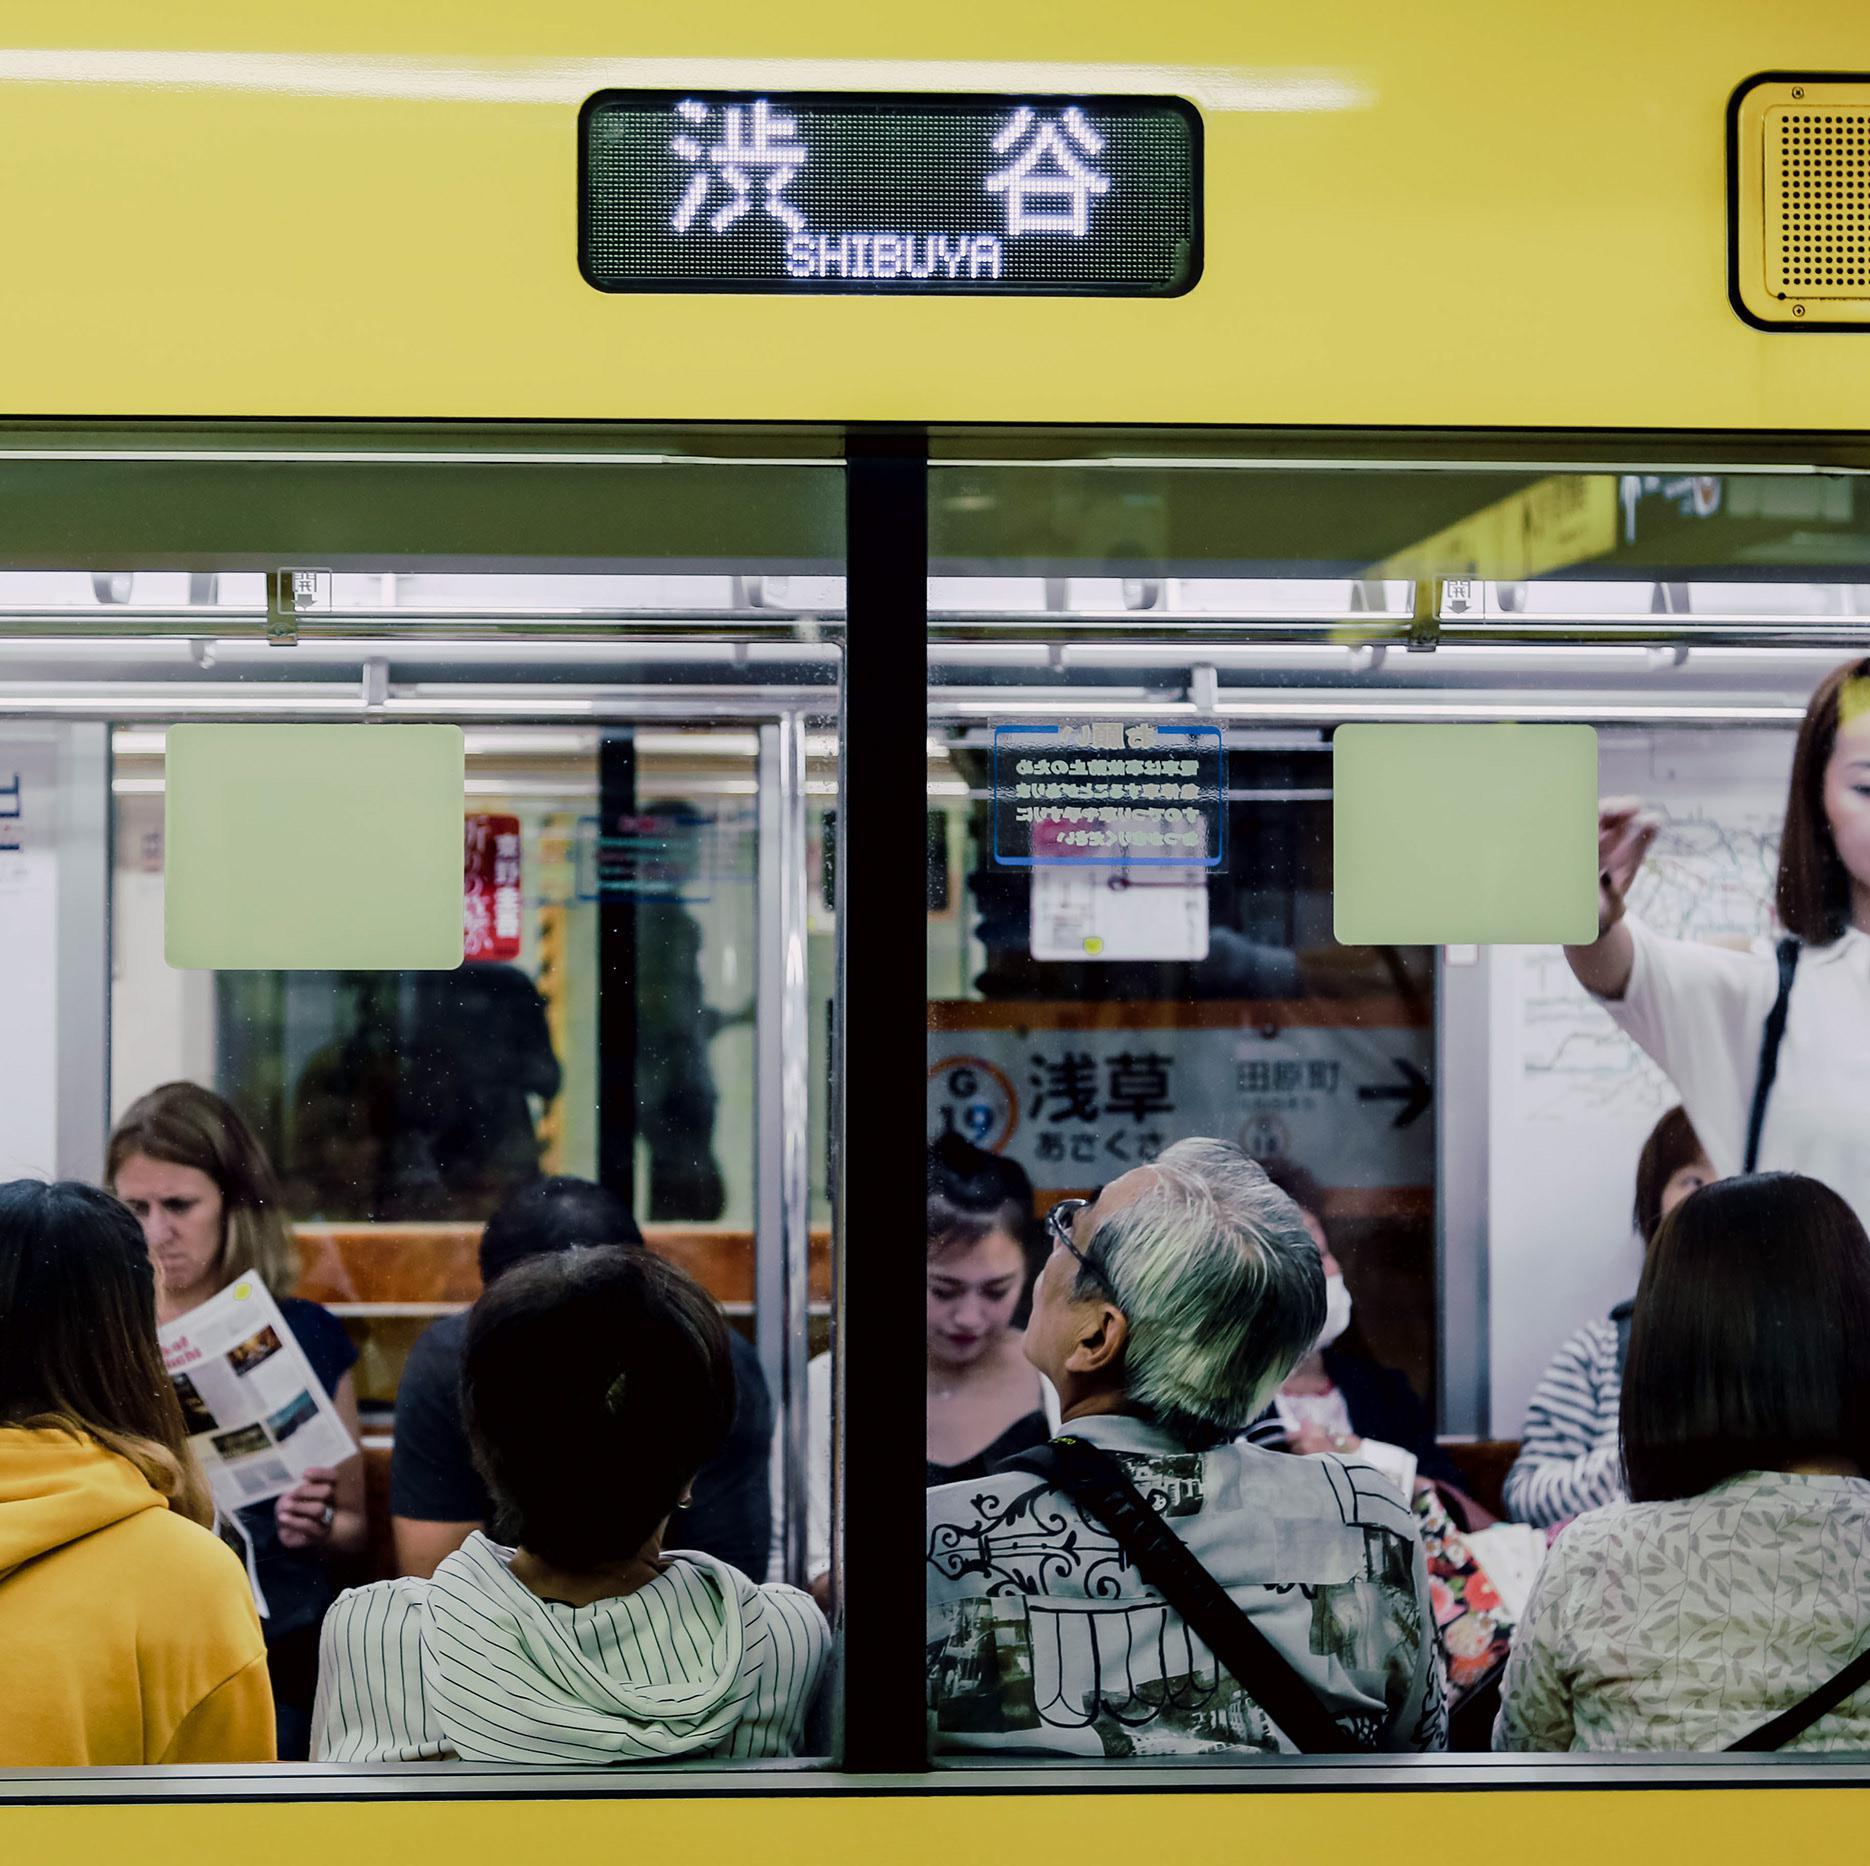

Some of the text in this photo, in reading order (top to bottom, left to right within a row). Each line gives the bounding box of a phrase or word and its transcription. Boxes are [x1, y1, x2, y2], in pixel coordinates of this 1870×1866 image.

[671, 100, 1111, 236] 渋谷
[787, 233, 1000, 279] SHIBUYA
[948, 1068, 977, 1097] G
[1027, 1051, 1175, 1123] 浅草
